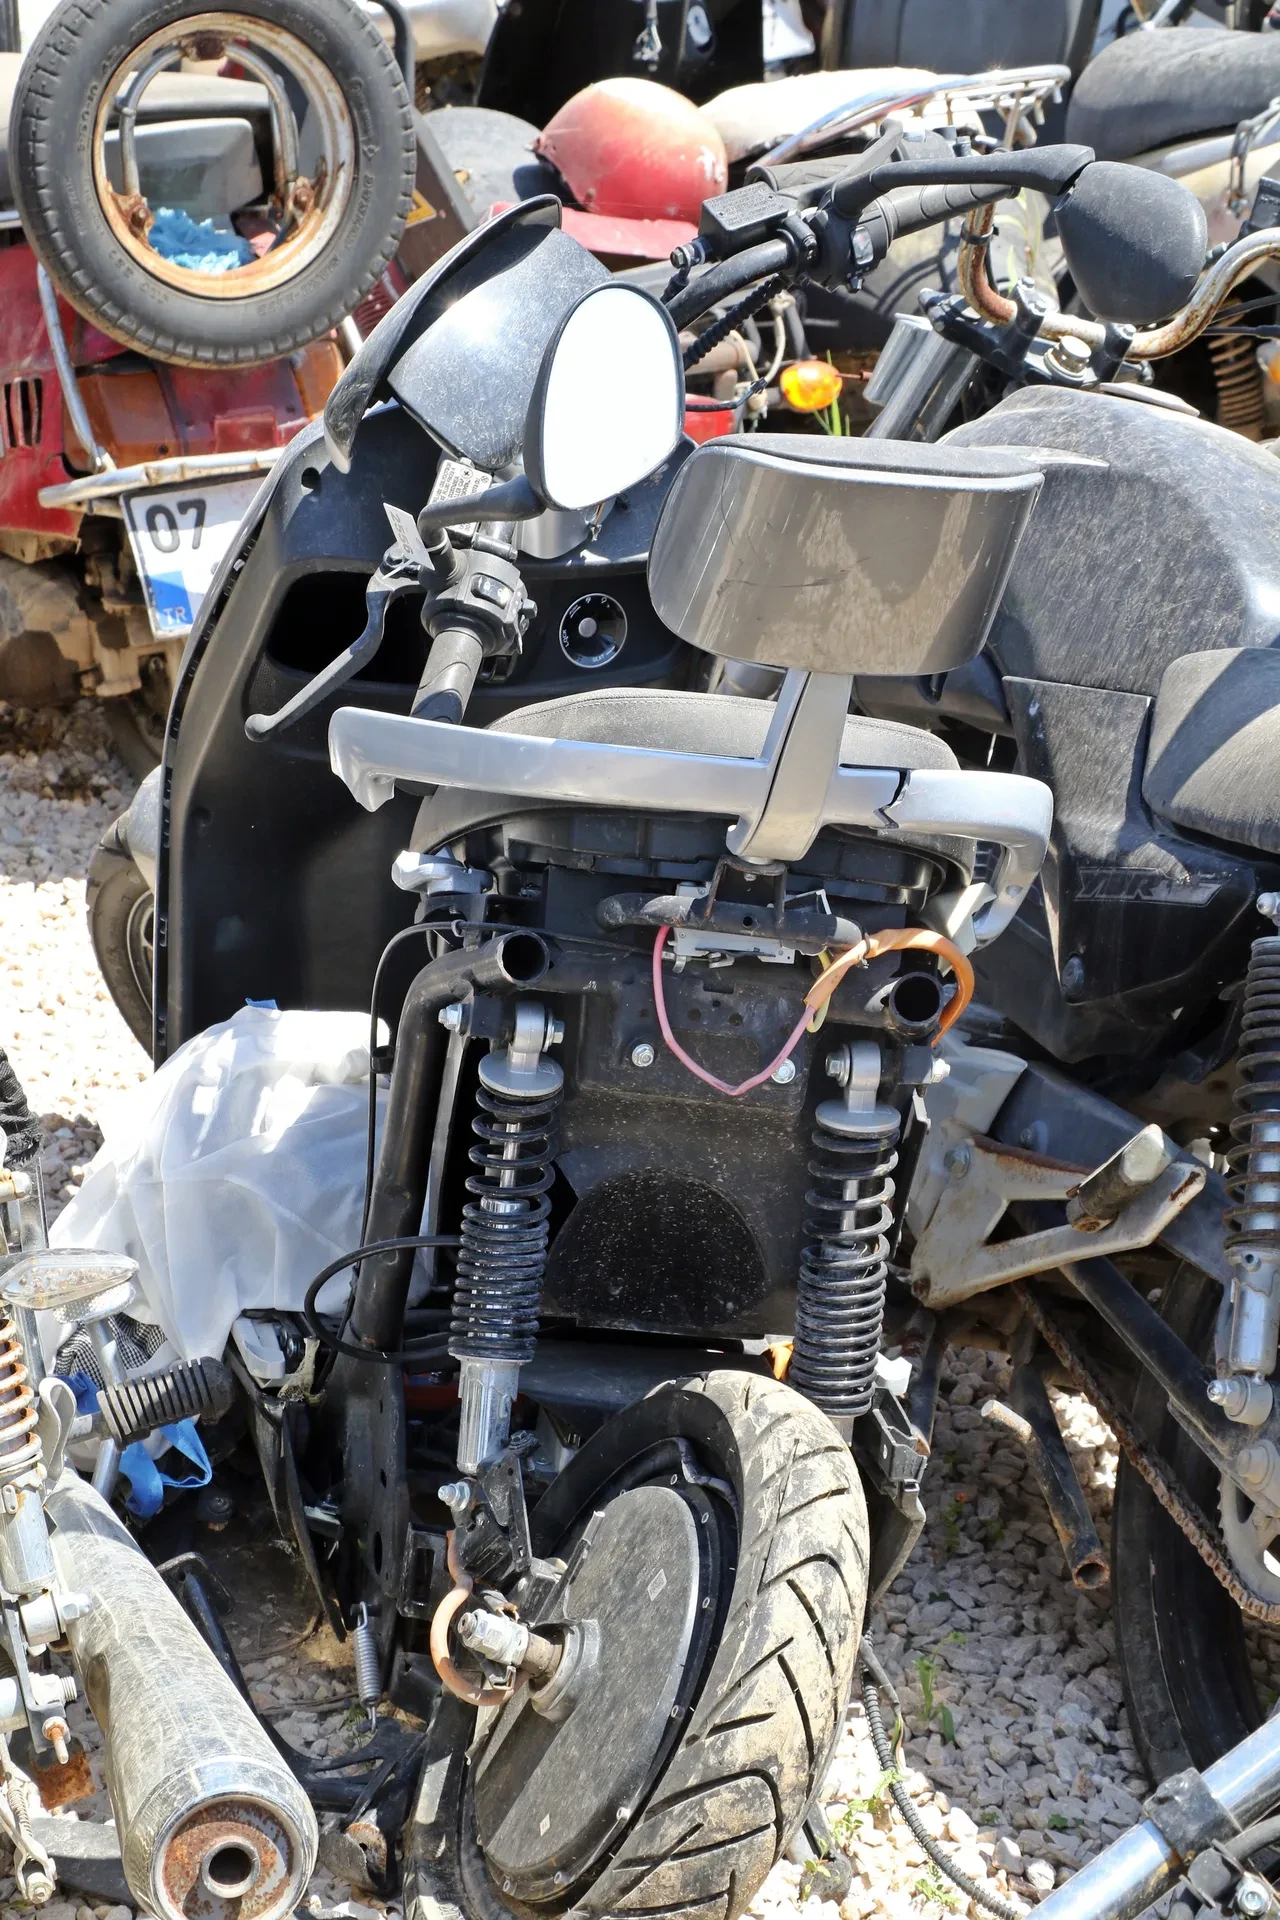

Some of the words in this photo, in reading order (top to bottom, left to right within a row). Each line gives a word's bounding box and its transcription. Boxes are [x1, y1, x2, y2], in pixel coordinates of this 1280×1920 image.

[146, 498, 206, 553] 07
[390, 511, 414, 555] 2556
[163, 607, 187, 624] TR
[562, 629, 570, 647] LOCK
